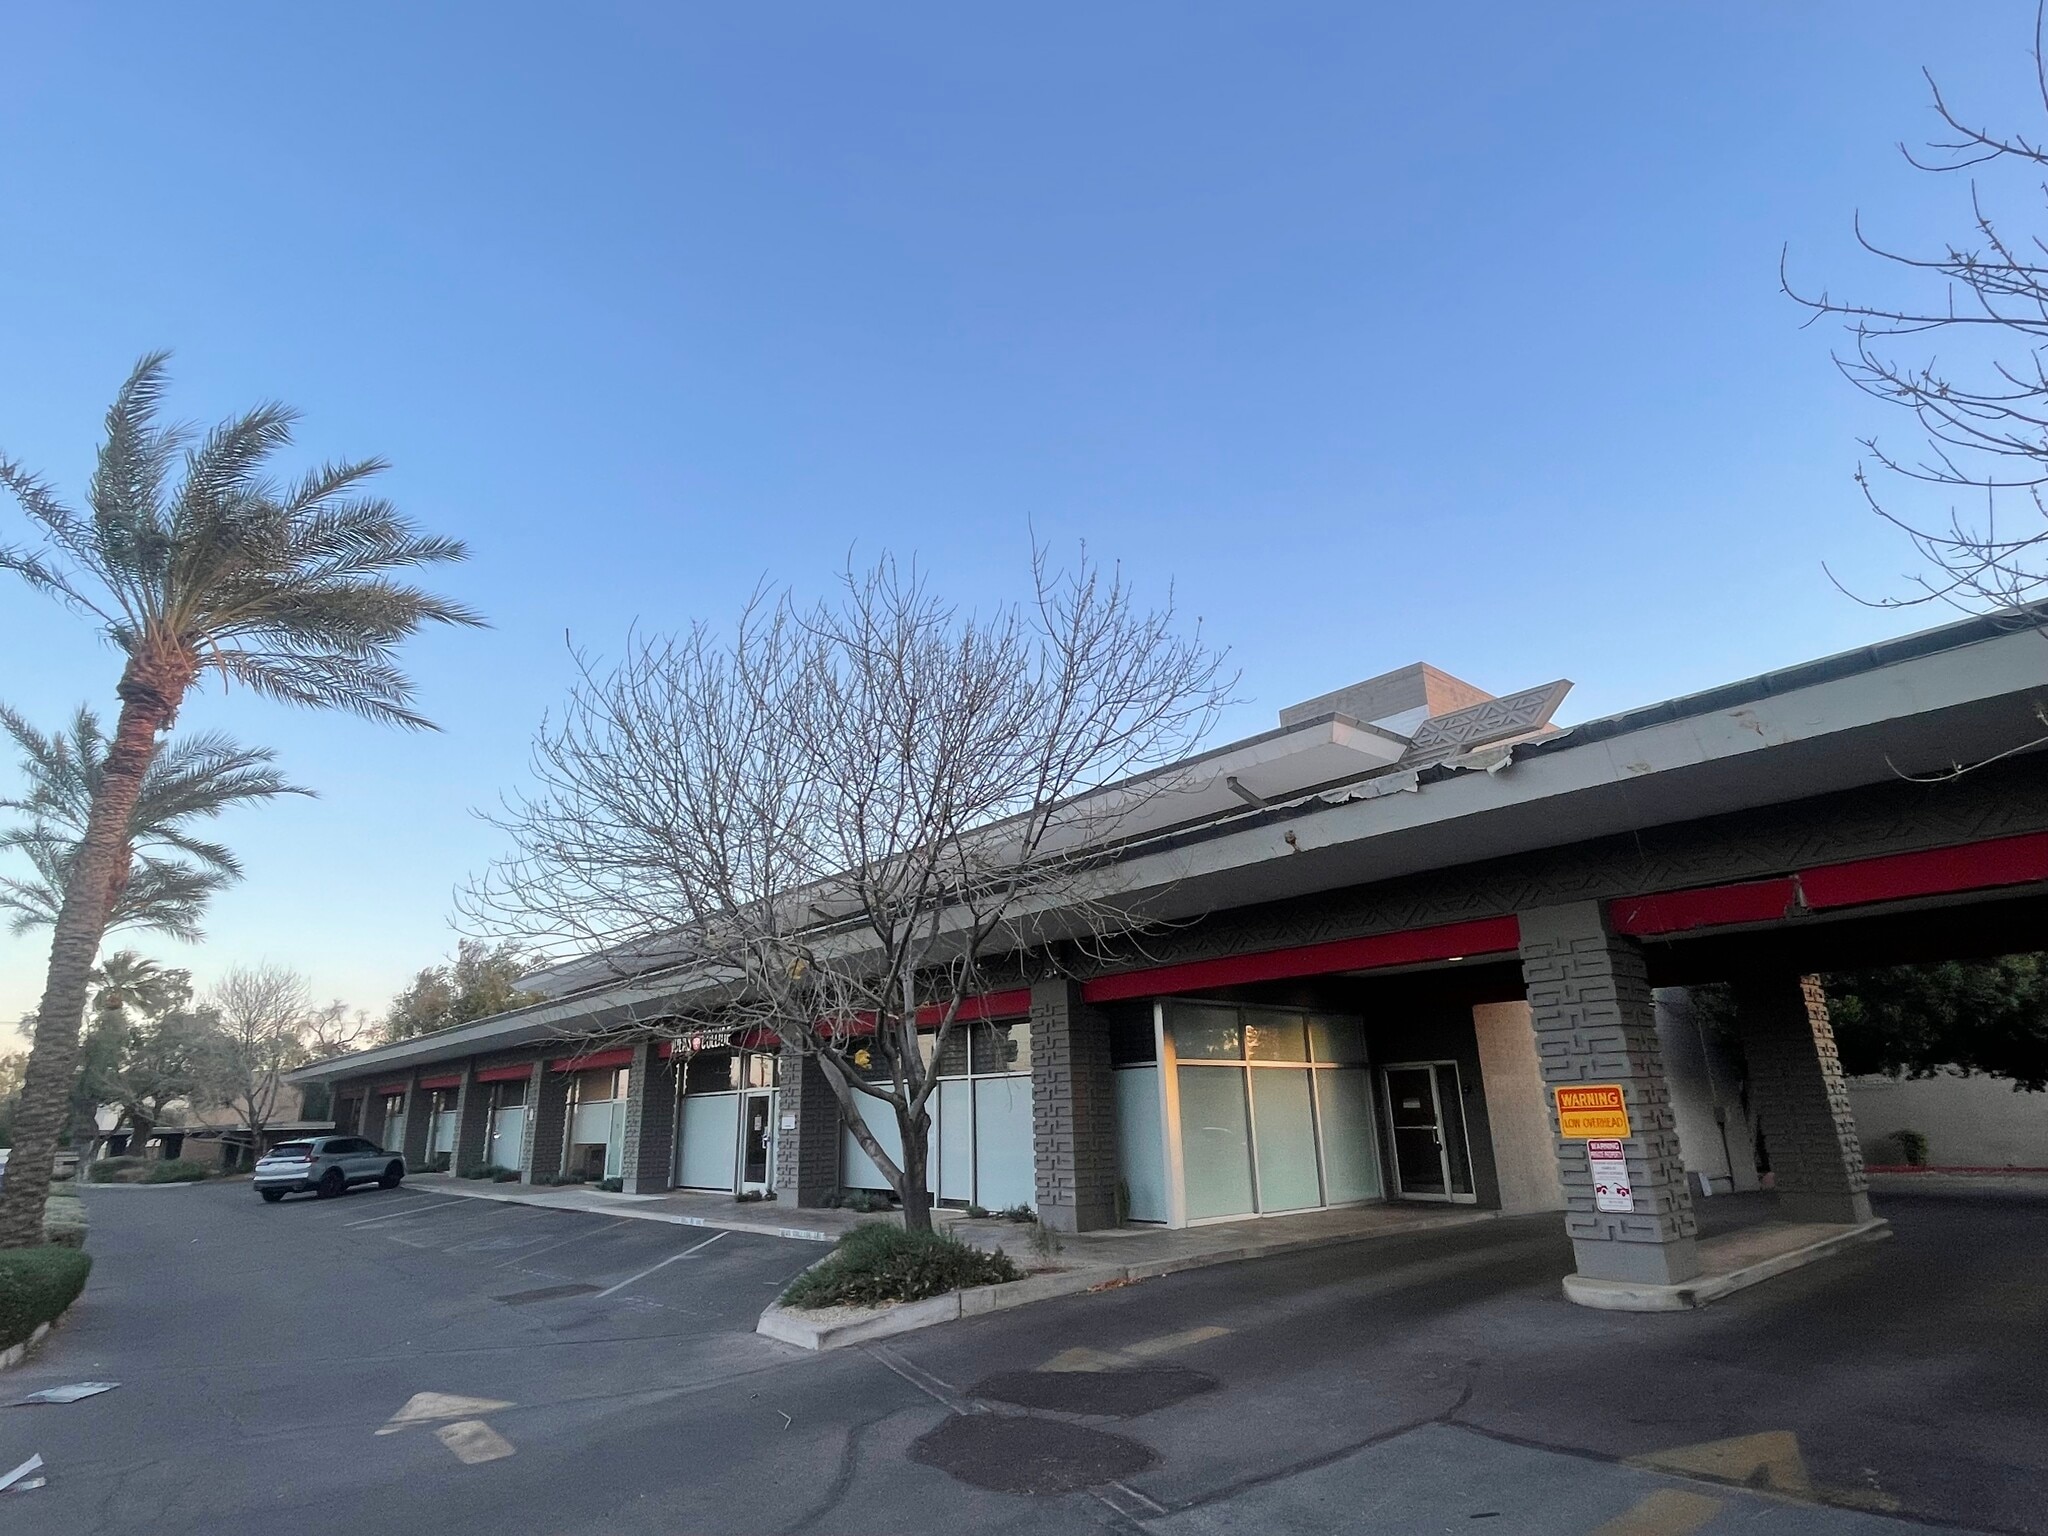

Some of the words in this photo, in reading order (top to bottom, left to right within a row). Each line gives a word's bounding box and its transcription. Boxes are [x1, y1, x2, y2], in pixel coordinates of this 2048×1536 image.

[1561, 1092, 1618, 1107] WARNING
[1564, 1119, 1580, 1128] LOW
[1583, 1116, 1623, 1128] OVERHEAD
[1590, 1142, 1619, 1150] WARNING
